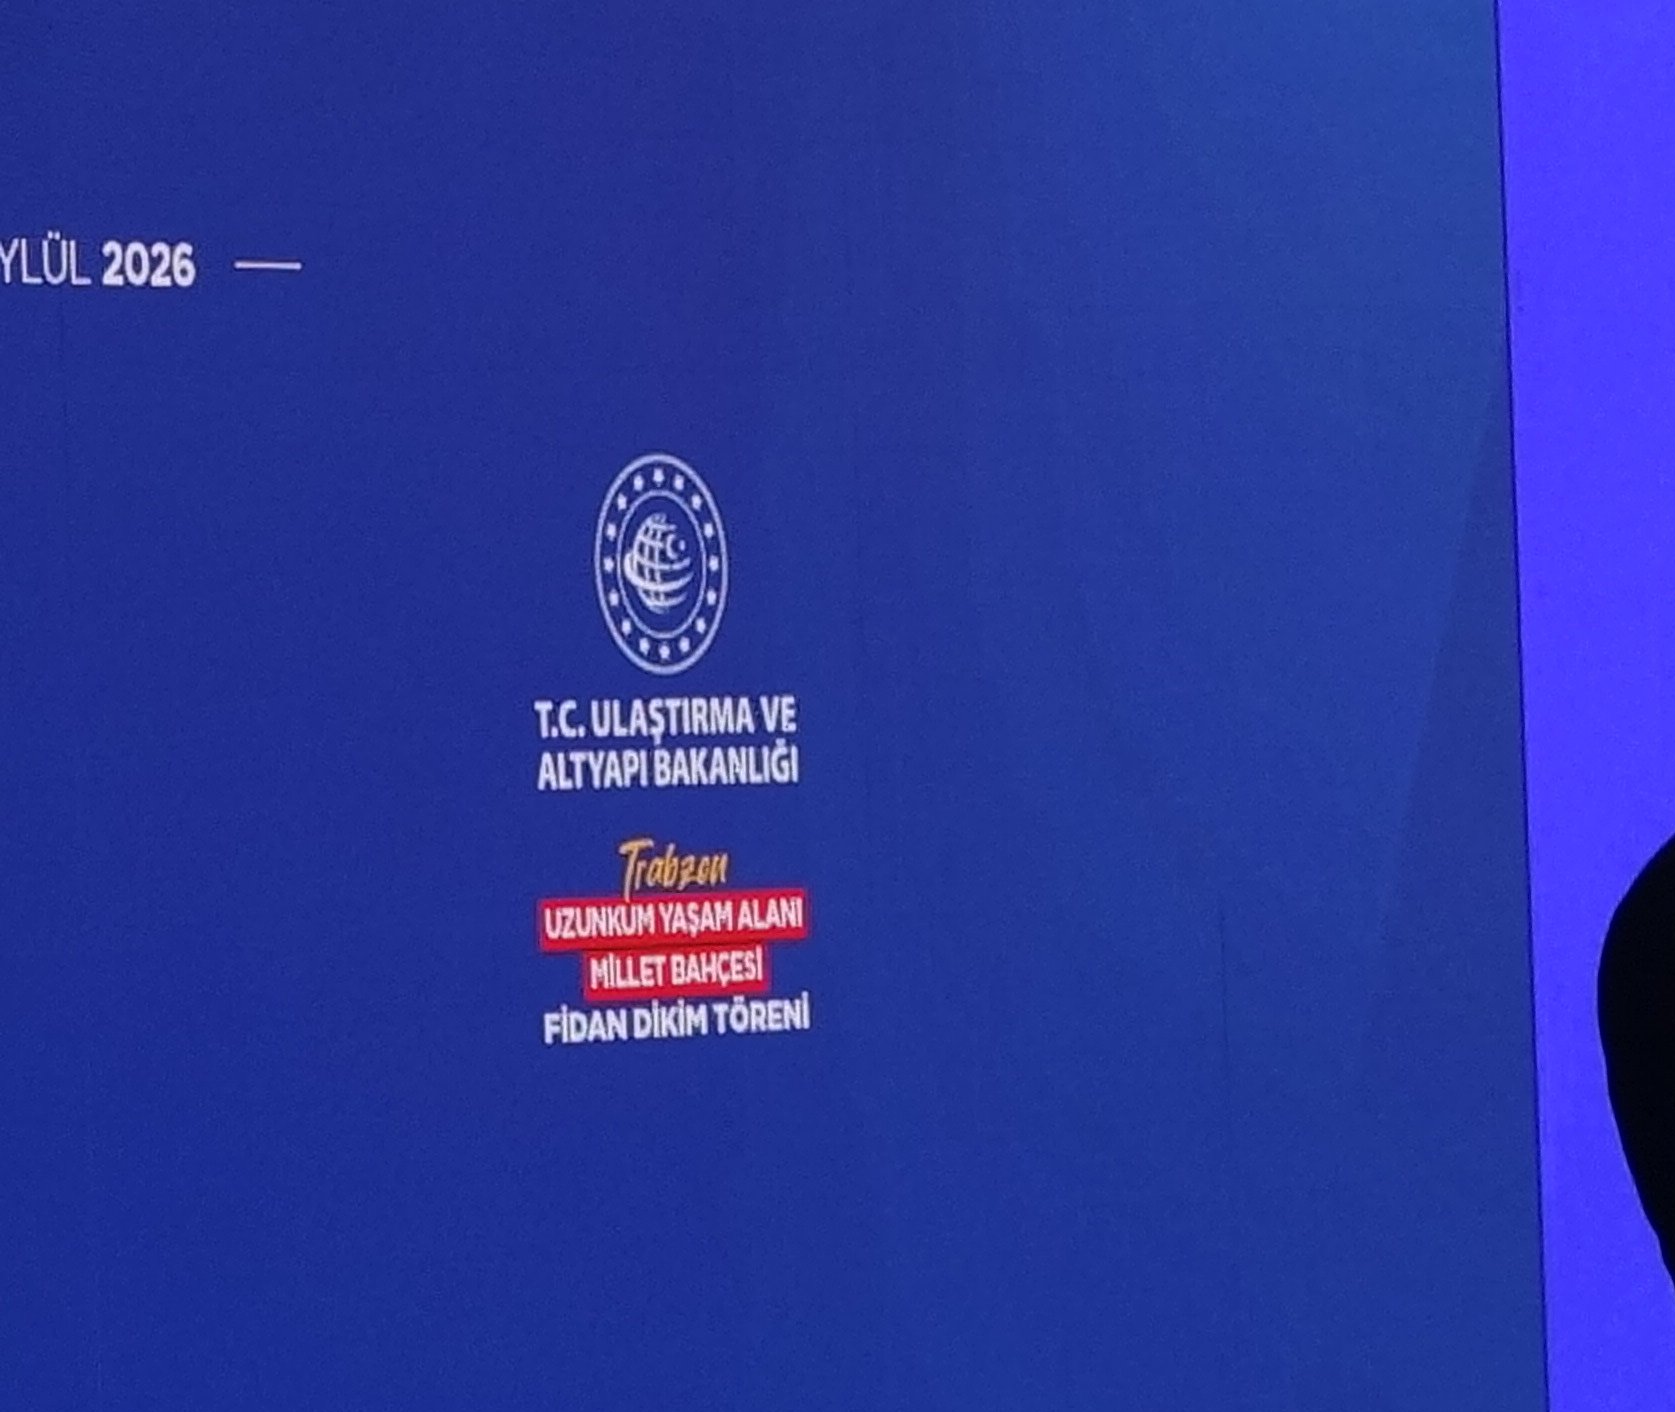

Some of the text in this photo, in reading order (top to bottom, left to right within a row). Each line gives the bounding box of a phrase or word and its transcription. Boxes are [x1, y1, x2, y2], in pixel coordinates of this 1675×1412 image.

[101, 241, 196, 287] 2026
[534, 695, 797, 745] T.C. ULAŞTIRMA VE
[537, 738, 799, 790] ALTYAPI BAKANLIĞI
[618, 837, 729, 903] Trabzon
[544, 896, 803, 940] UZUNKUM YAŞAM ALANI
[590, 945, 763, 990] MİLLET BAHÇESİ
[543, 991, 811, 1044] FİDAN DİKİM TÖRENİ
